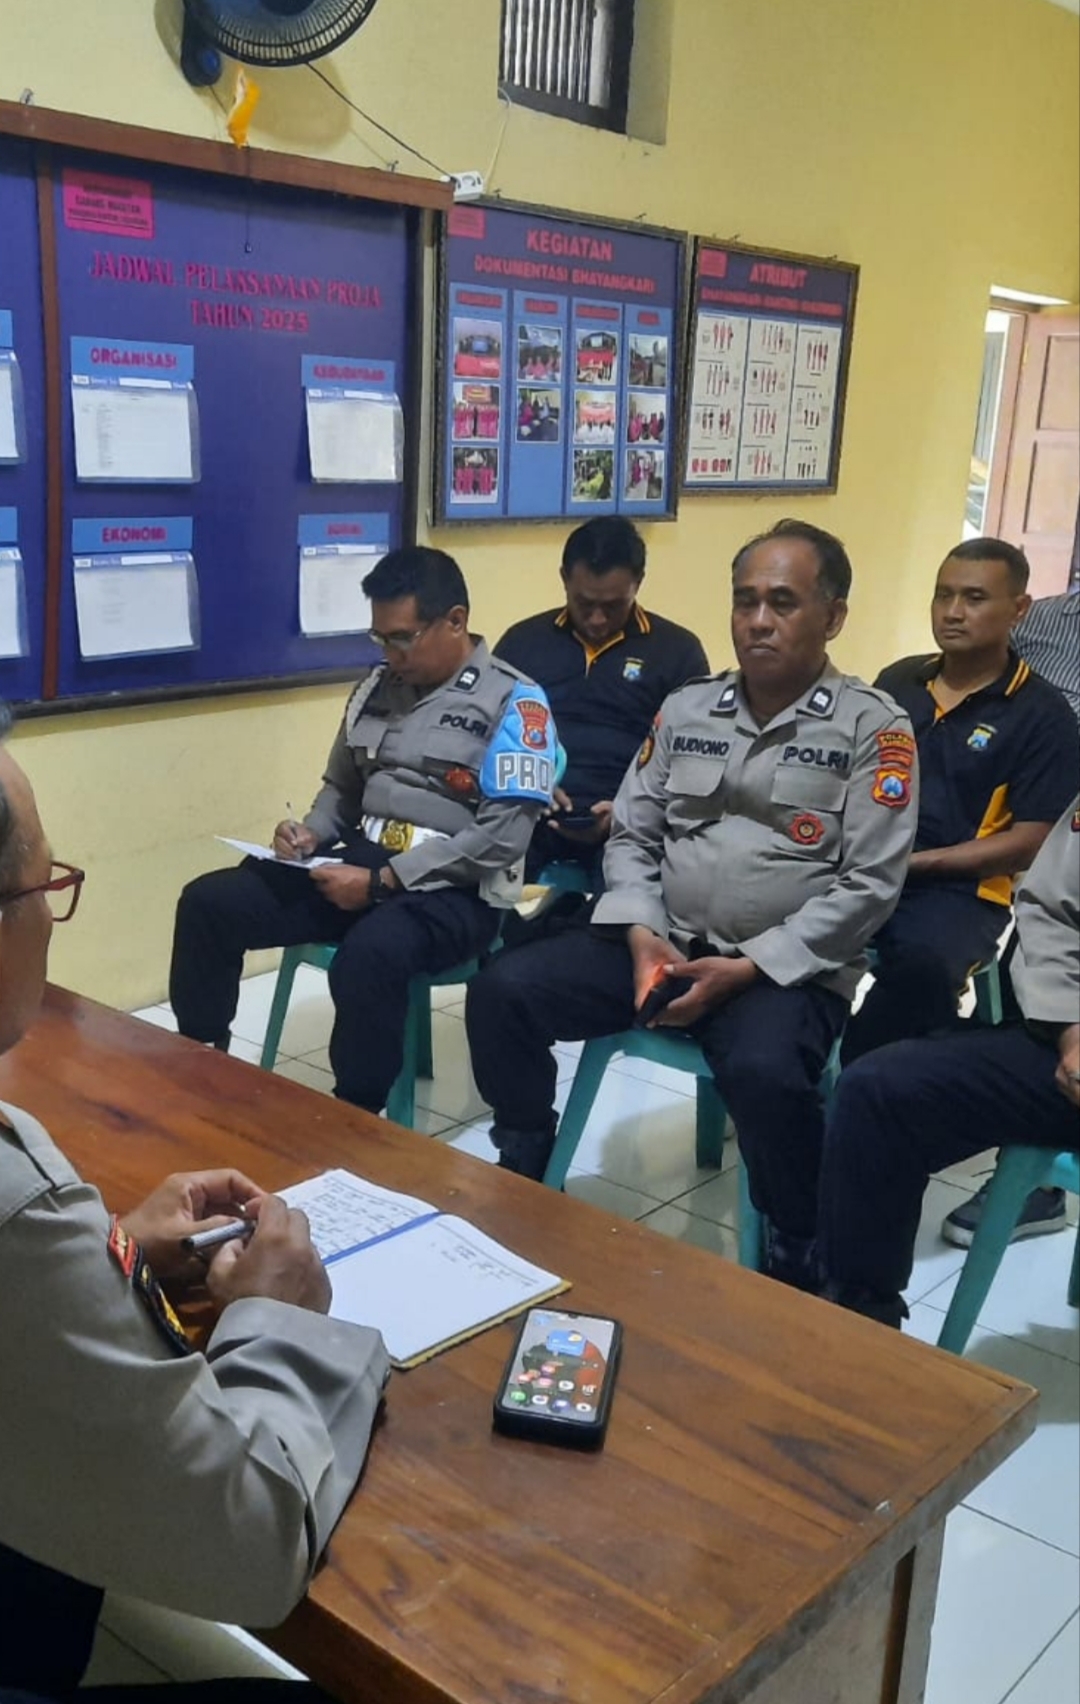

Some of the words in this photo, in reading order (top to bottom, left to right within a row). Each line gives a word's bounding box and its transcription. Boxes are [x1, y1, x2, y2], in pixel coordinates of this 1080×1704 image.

[526, 229, 613, 261] KEGIATAN
[474, 254, 568, 281] DOKUMENTASI
[749, 263, 808, 288] ATRIBUT
[91, 251, 177, 287] JADWAL
[185, 263, 321, 301] PELAKSANAAN
[327, 279, 382, 309] PROJA
[191, 299, 253, 330] TAHUN
[261, 307, 309, 334] 2025
[91, 347, 177, 369] ORGANISASI
[102, 527, 167, 542] EKONOMI
[440, 713, 489, 737] POLRI
[673, 736, 730, 756] BUDIONO
[783, 746, 850, 770] POLRI
